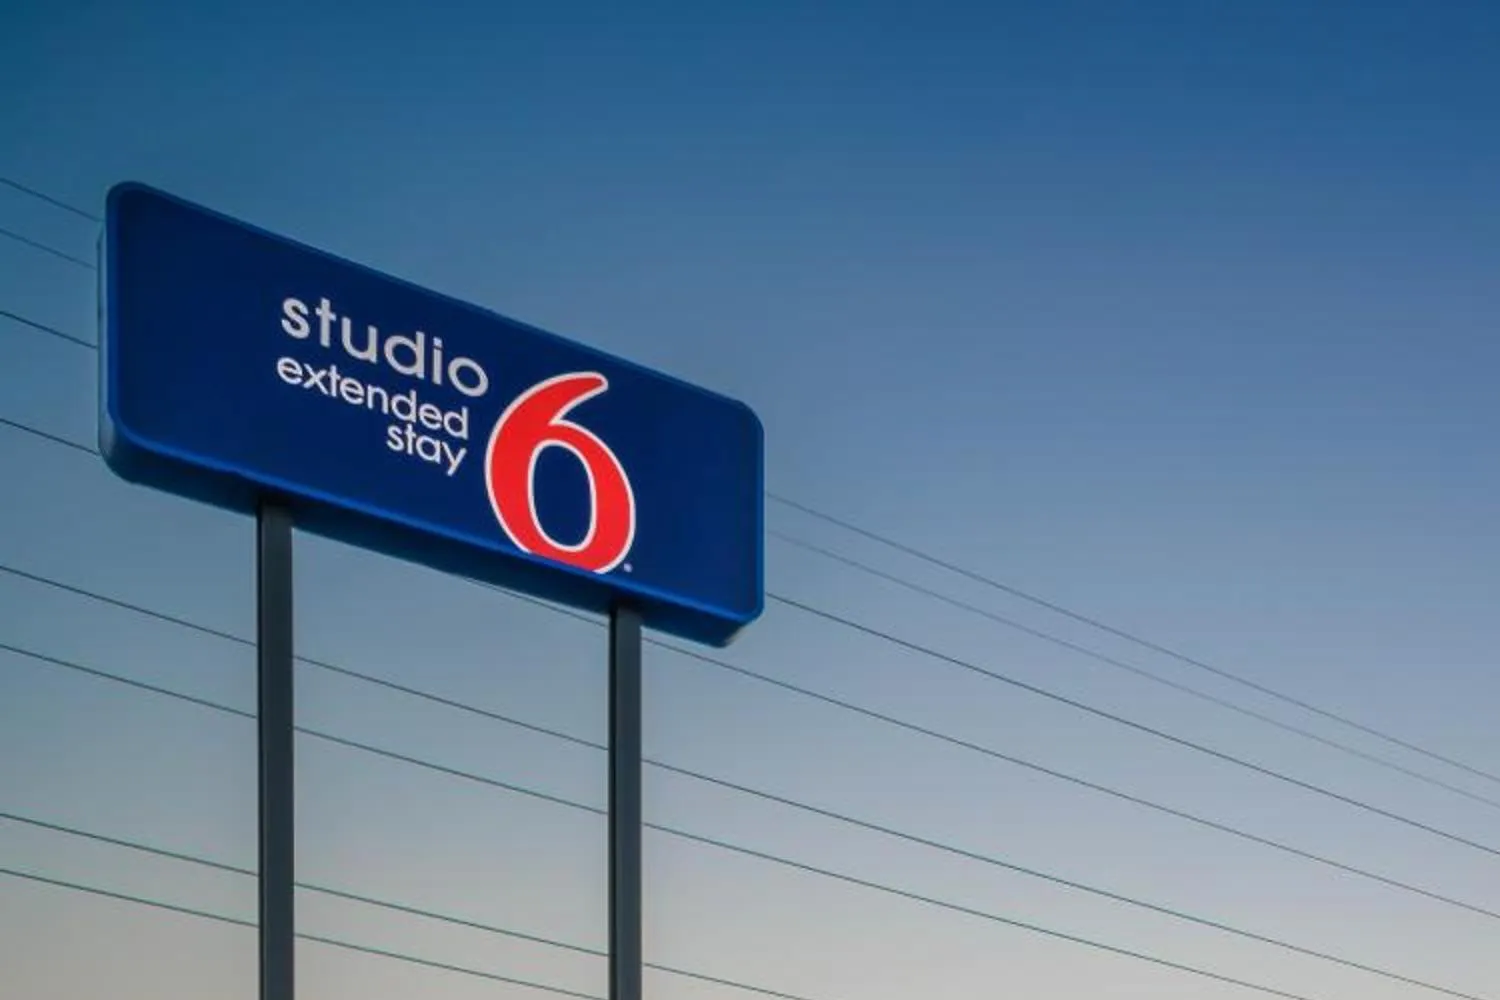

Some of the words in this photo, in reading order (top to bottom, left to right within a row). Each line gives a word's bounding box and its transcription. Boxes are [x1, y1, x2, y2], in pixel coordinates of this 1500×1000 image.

[281, 297, 489, 397] studio
[276, 356, 468, 440] extended
[386, 423, 467, 476] stay
[485, 371, 636, 575] 6
